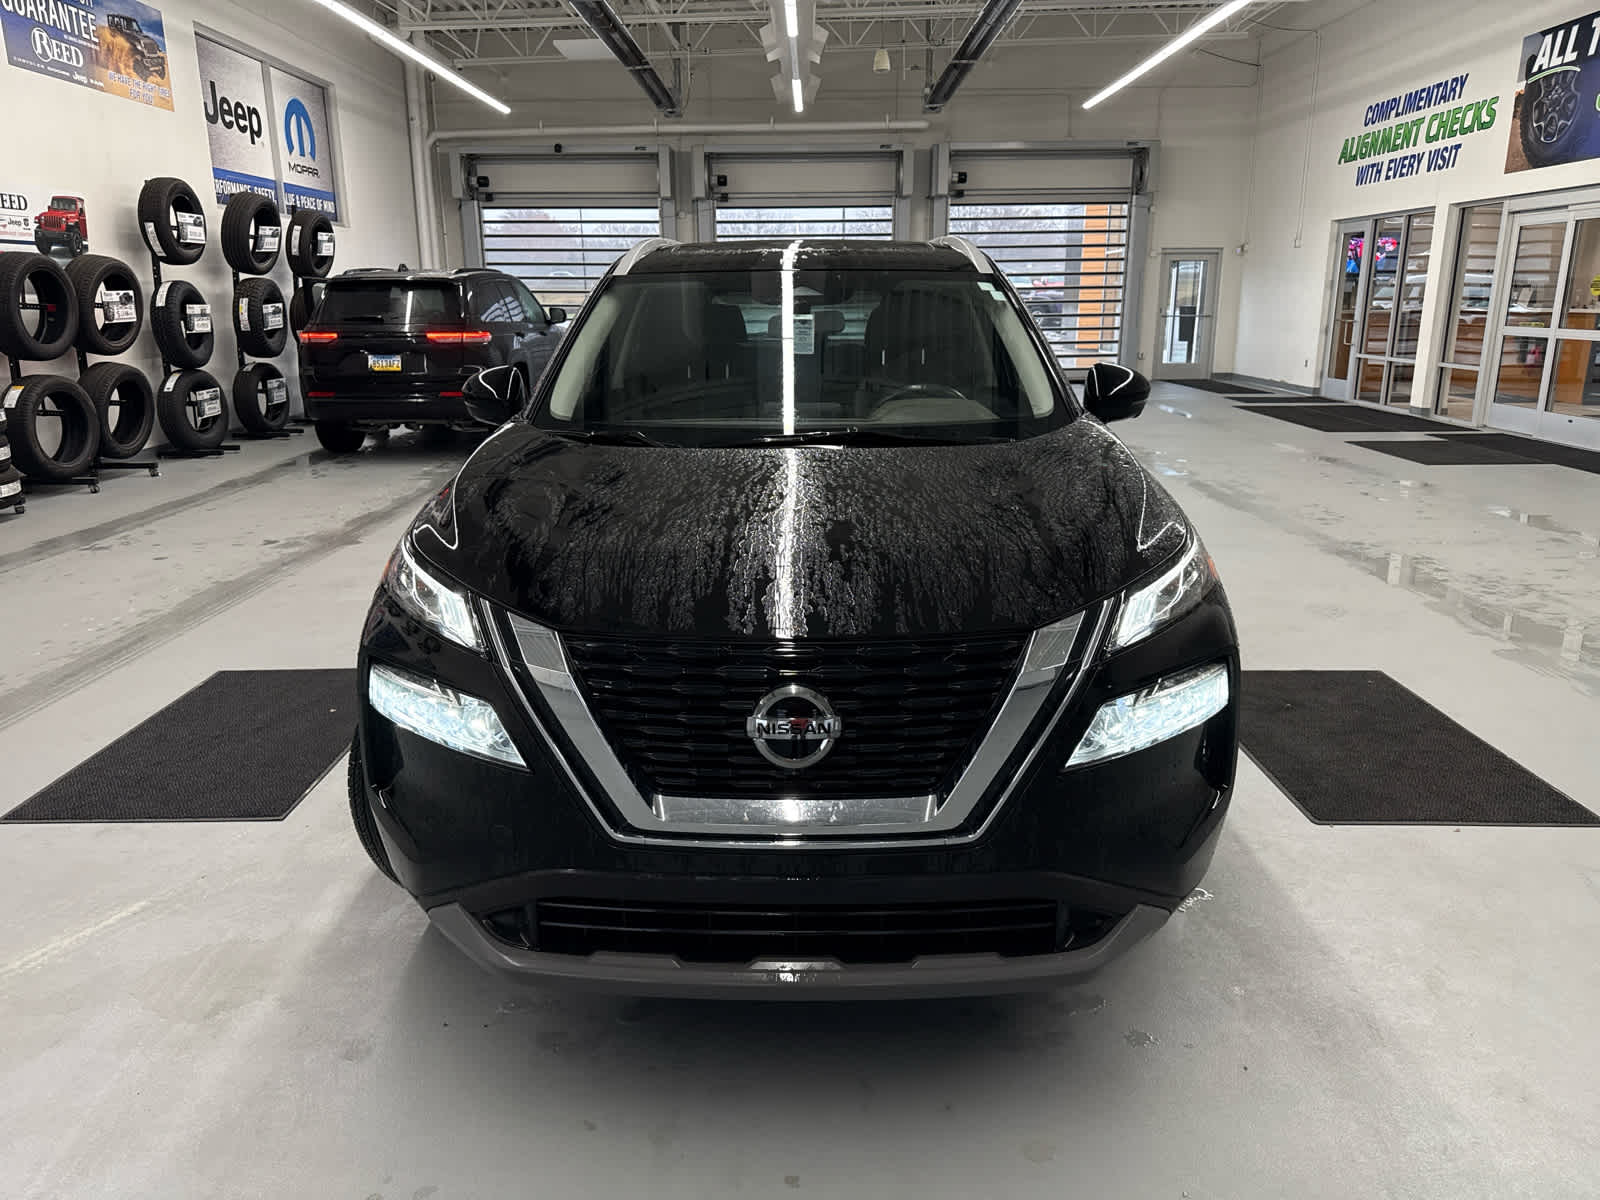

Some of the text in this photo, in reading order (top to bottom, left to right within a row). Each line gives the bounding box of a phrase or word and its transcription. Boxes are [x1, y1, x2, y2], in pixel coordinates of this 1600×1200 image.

[31, 27, 83, 68] REED
[1531, 24, 1579, 73] ALL
[203, 80, 262, 146] Jeep
[1363, 73, 1470, 127] COMPLIMENTARY
[1338, 96, 1500, 165] ALIGNMENT CHECKS
[288, 162, 319, 178] MOPAR
[1355, 143, 1462, 186] WITH EVERY VISIT
[0, 193, 28, 211] EED
[757, 721, 832, 735] NISSAN
